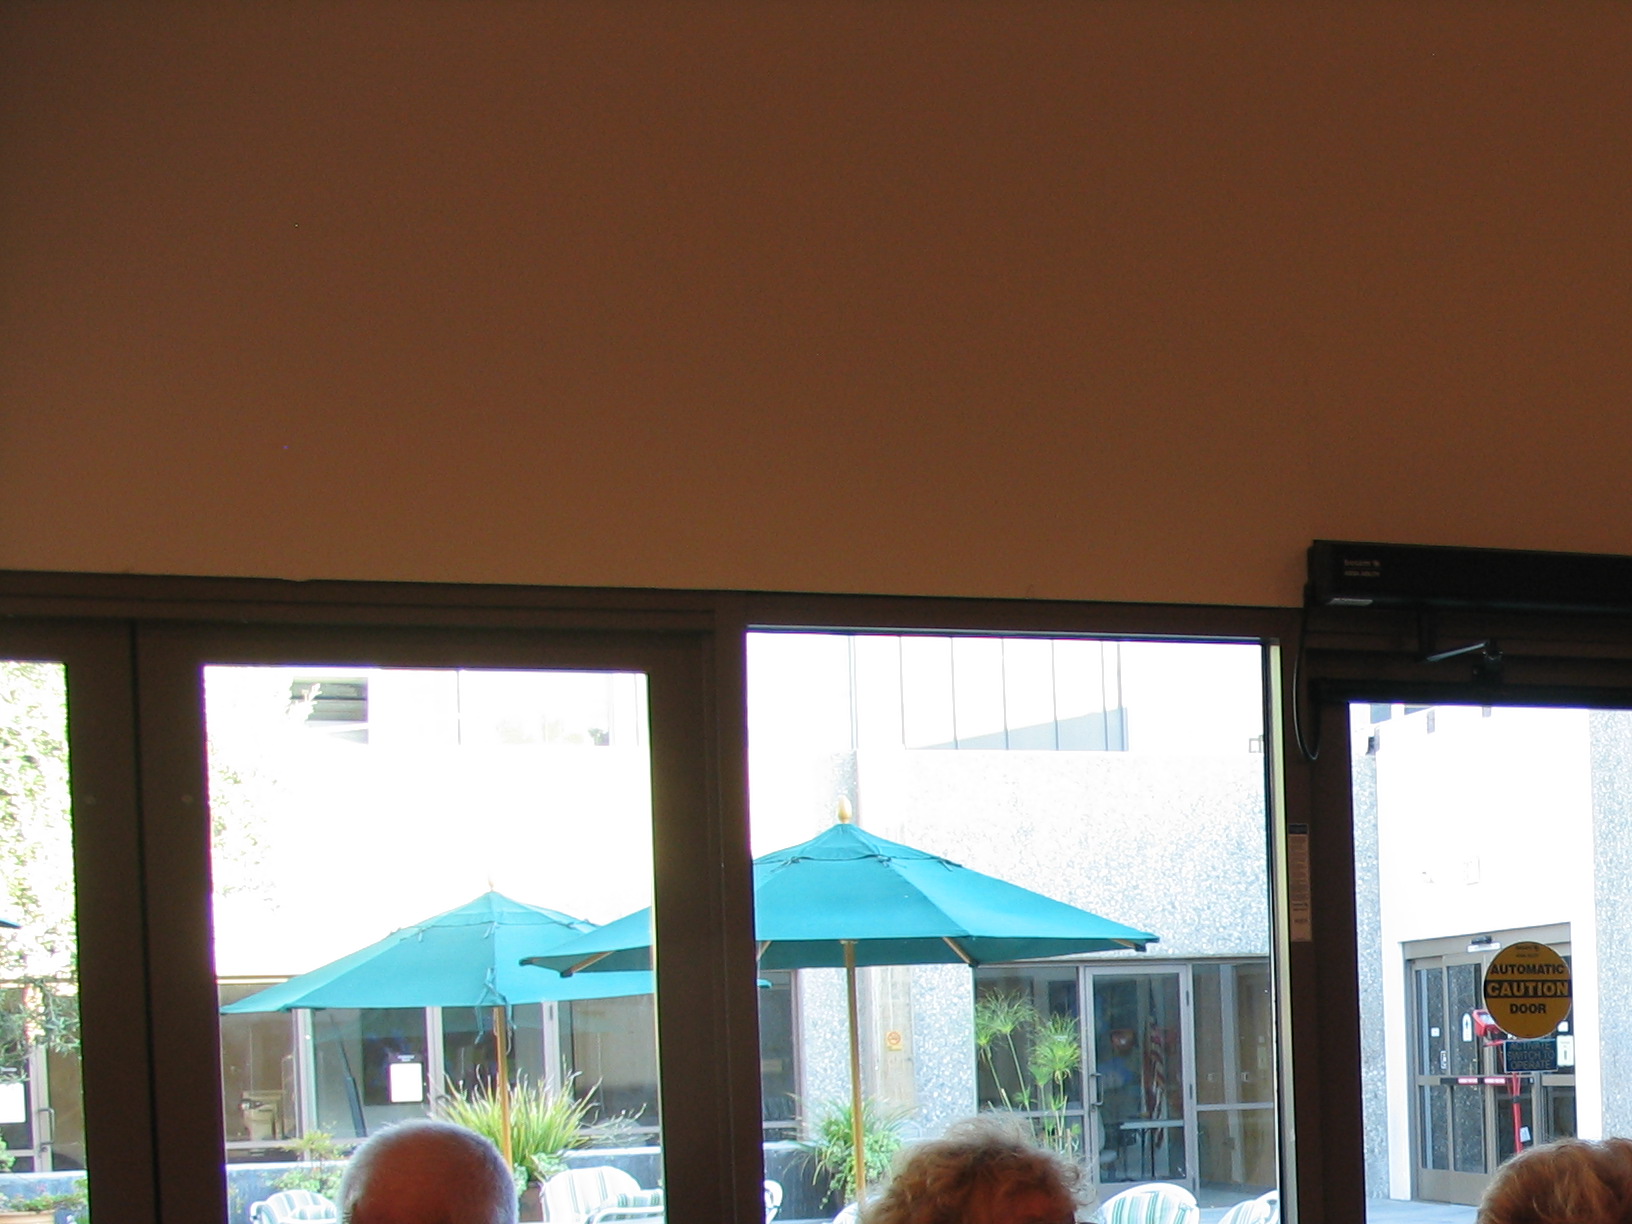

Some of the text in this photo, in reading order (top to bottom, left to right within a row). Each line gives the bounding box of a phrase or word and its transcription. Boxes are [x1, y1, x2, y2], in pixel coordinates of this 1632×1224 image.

[1490, 963, 1565, 975] AUTOMATIC
[1486, 981, 1569, 997] CAUTION
[1509, 1003, 1547, 1014] DOOR
